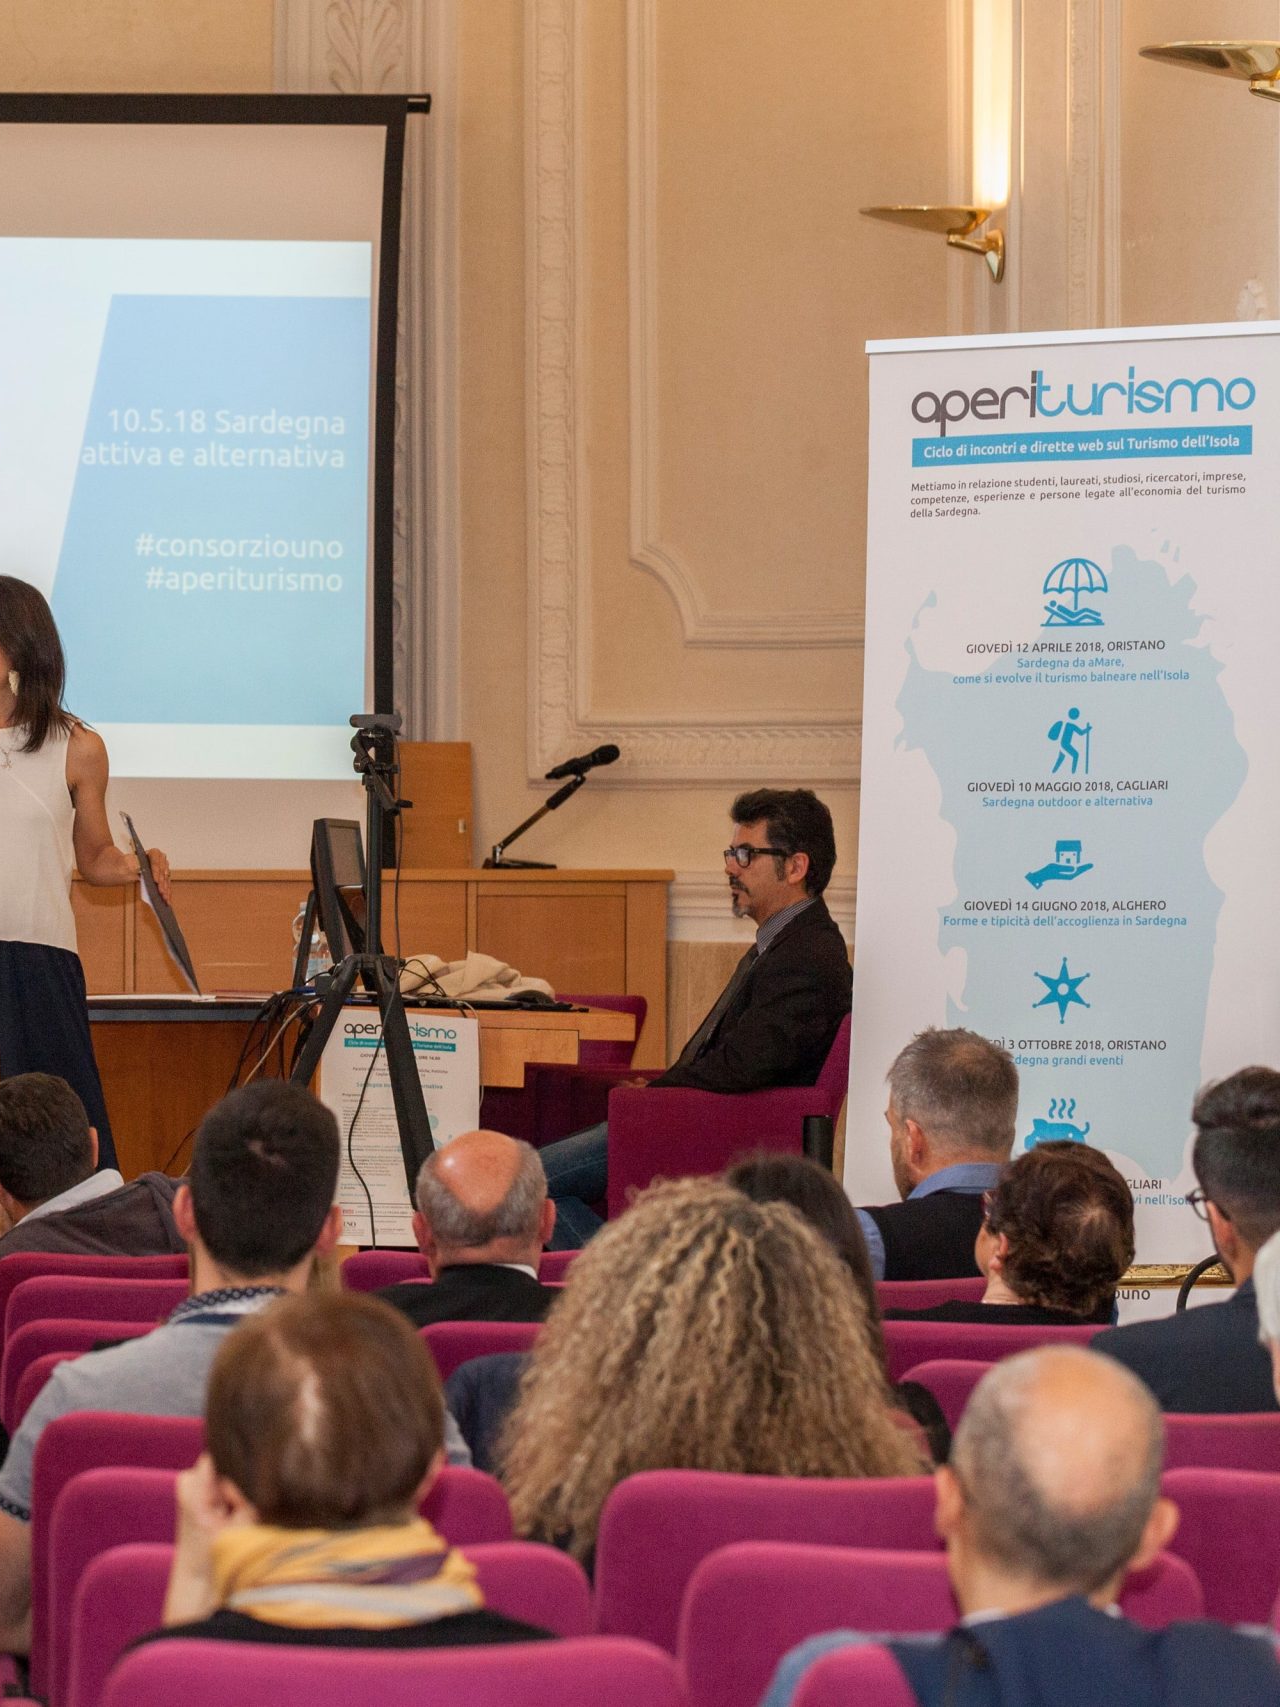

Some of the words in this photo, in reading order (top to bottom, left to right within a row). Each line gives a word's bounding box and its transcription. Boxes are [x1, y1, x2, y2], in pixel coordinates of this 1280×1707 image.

[911, 366, 1256, 437] aperiturismo
[108, 409, 206, 433] 10.5.18
[215, 409, 345, 440] Sardegna
[81, 441, 162, 466] attiva
[169, 447, 185, 466] e
[193, 441, 345, 468] alternativa
[923, 445, 953, 459] Ciclo
[956, 444, 967, 457] di
[970, 441, 1017, 456] incontri
[1019, 444, 1028, 453] e
[1030, 439, 1075, 453] dirette
[1078, 438, 1104, 452] web
[1106, 437, 1124, 451] sul
[1127, 436, 1178, 450] Turismo
[911, 481, 956, 492] Mettiamo
[958, 480, 967, 490] in
[968, 478, 1012, 489] relazione
[1014, 476, 1058, 489] studenti,
[1060, 475, 1101, 487] laureati,
[1103, 473, 1144, 486] studiosi,
[1145, 472, 1201, 484] ricercatori,
[1202, 471, 1246, 484] imprese,
[910, 494, 970, 506] competenze,
[973, 491, 1026, 504] esperienze
[1029, 492, 1036, 500] e
[1039, 490, 1081, 502] persone
[1084, 488, 1116, 500] legate
[1186, 485, 1203, 495] del
[1206, 484, 1246, 495] turismo
[910, 508, 933, 519] della
[935, 506, 981, 518] Sardegna.
[135, 533, 344, 559] #consorziouno
[146, 567, 343, 595] #aperiturismo
[966, 640, 1013, 654] GIOVEDÌ
[1016, 642, 1029, 653] 12
[1031, 642, 1073, 653] APRILE
[1075, 641, 1104, 653] 2018,
[1106, 639, 1166, 652] ORISTANO
[1017, 656, 1070, 670] Sardegna
[1072, 656, 1086, 668] da
[1089, 656, 1125, 669] aMare,
[952, 675, 981, 684] come
[983, 672, 993, 683] si
[995, 671, 1033, 683] evolve
[1035, 671, 1043, 682] il
[1044, 671, 1088, 683] turismo
[1090, 670, 1137, 682] balneare
[967, 779, 1015, 793] GIOVEDÌ
[1018, 781, 1032, 792] 10
[1034, 781, 1082, 792] MAGGIO
[1084, 781, 1114, 793] 2018,
[1116, 780, 1168, 791] CAGLIARI
[982, 797, 1035, 809] Sardegna
[1038, 797, 1082, 807] outdoor
[1084, 798, 1092, 807] e
[1094, 795, 1153, 807] alternativa
[964, 898, 1012, 912] GIOVEDÌ
[1016, 901, 1029, 911] 14
[1031, 901, 1078, 912] GIUGNO
[1080, 901, 1109, 913] 2018,
[1112, 900, 1167, 911] ALGHERO
[943, 915, 979, 926] Forme
[980, 917, 988, 926] e
[990, 915, 1030, 928] tipicità
[1122, 915, 1132, 926] in
[1135, 915, 1187, 928] Sardegna
[1008, 1039, 1015, 1050] 3
[1017, 1039, 1073, 1051] OTTOBRE
[1075, 1039, 1104, 1052] 2018,
[1107, 1039, 1167, 1051] ORISTANO
[1014, 1054, 1049, 1067] degna
[1052, 1054, 1087, 1067] grandi
[1089, 1054, 1124, 1066] eventi
[1126, 1179, 1162, 1190] GLIARI
